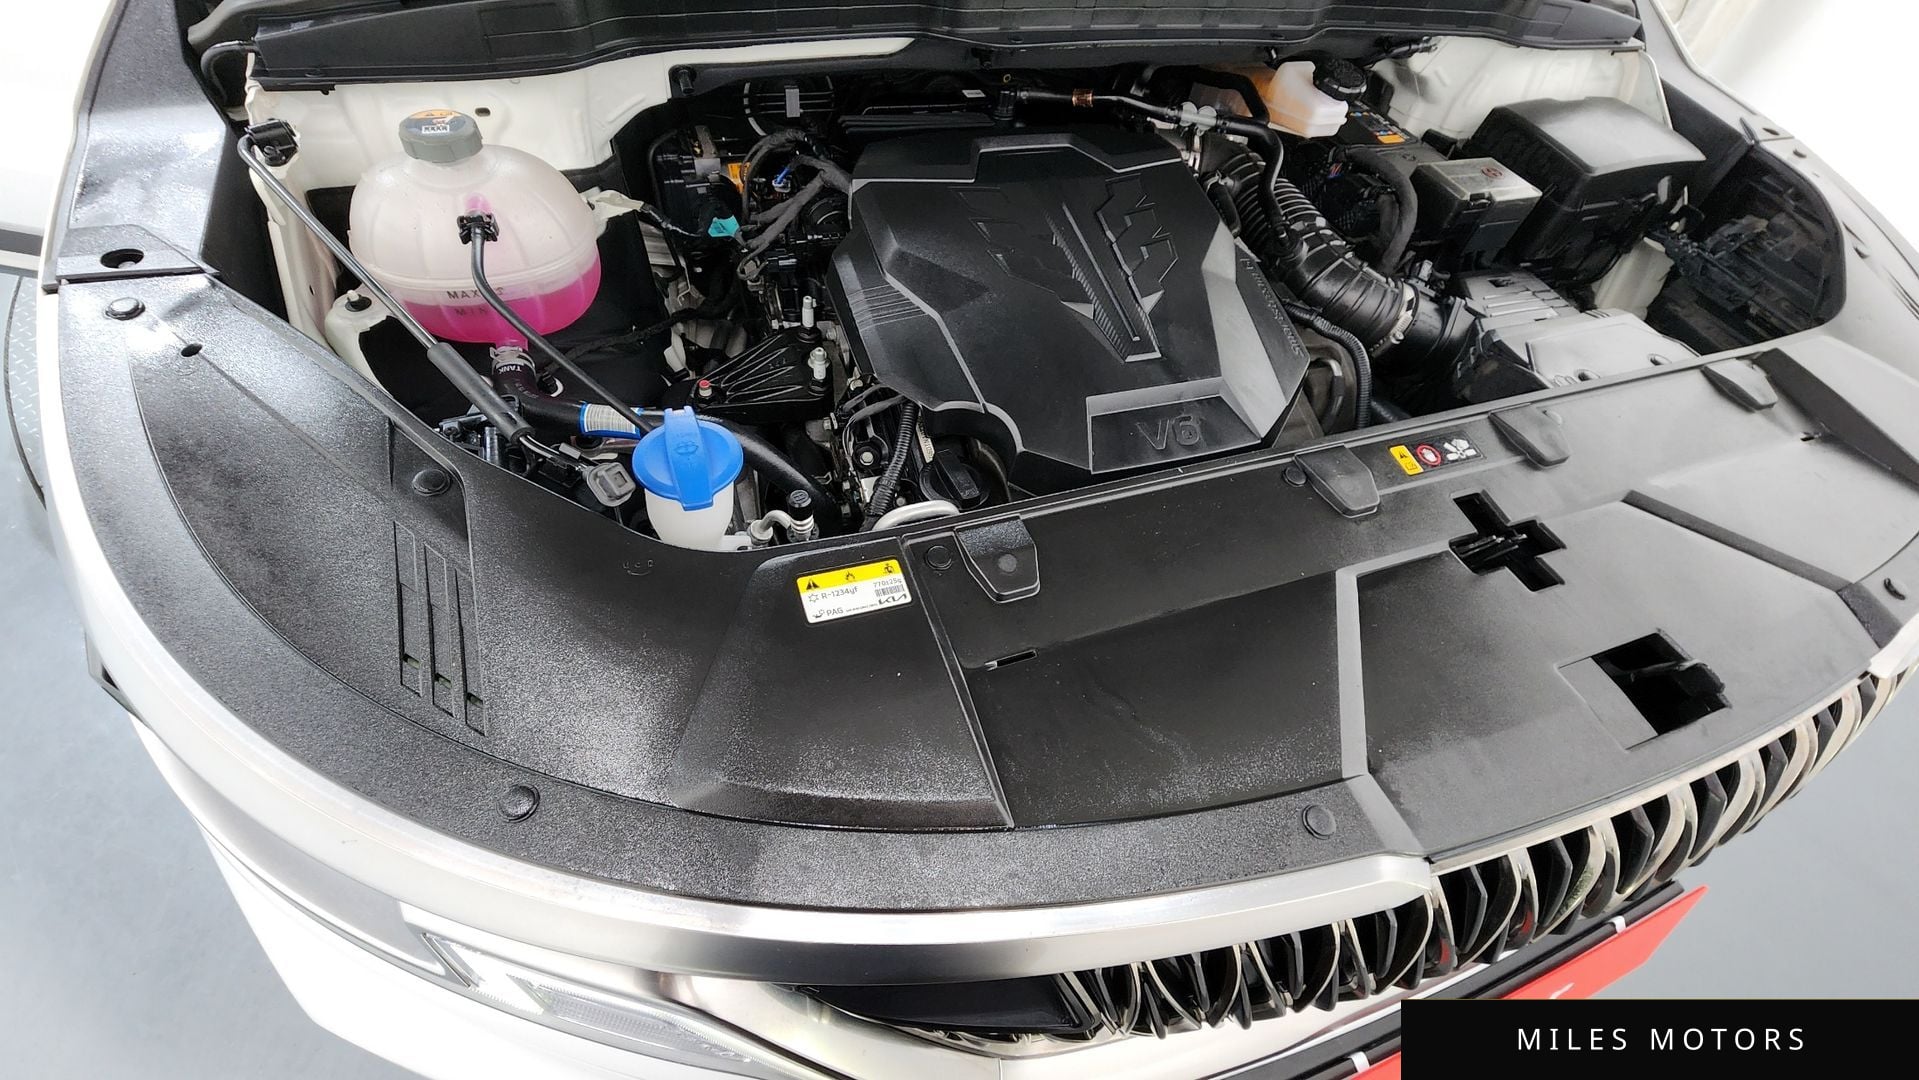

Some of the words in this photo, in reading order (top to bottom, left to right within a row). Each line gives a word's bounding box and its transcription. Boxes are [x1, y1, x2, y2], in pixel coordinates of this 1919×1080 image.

[446, 289, 481, 300] MAX
[498, 364, 522, 375] TANK
[1135, 414, 1200, 450] V6
[825, 607, 844, 617] PAG
